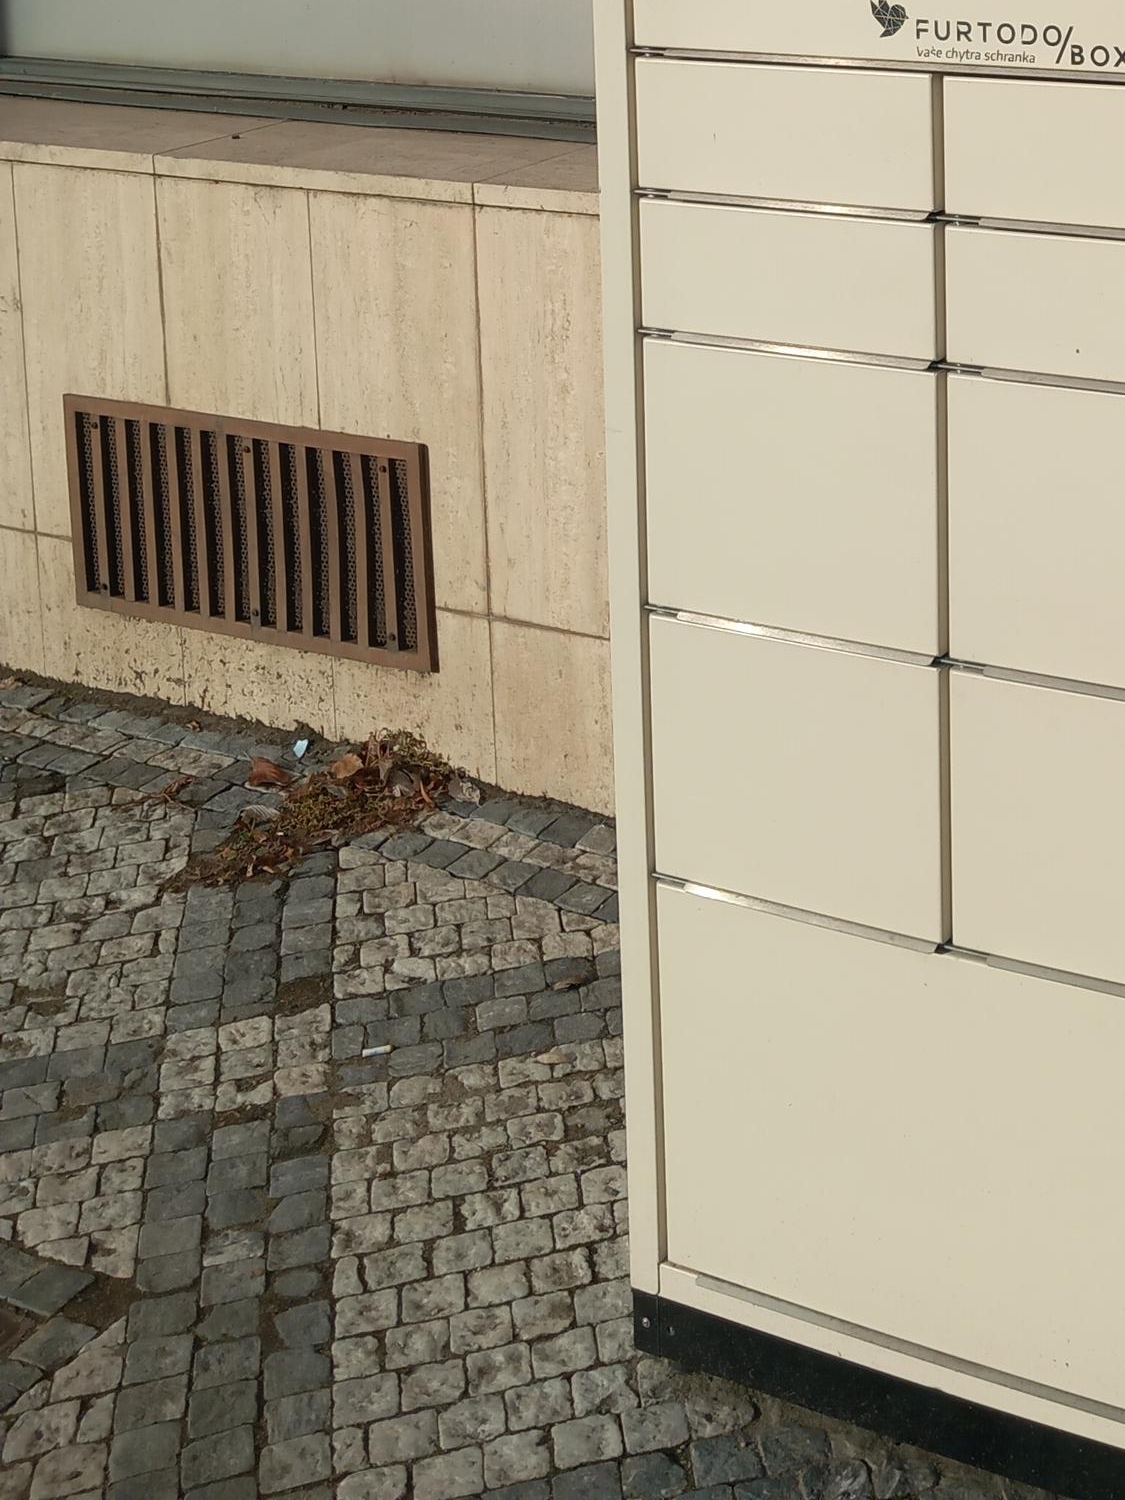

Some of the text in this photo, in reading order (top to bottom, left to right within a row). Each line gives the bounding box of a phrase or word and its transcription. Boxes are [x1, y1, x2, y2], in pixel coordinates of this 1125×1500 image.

[916, 46, 1036, 63] Vaše chytra schranka
